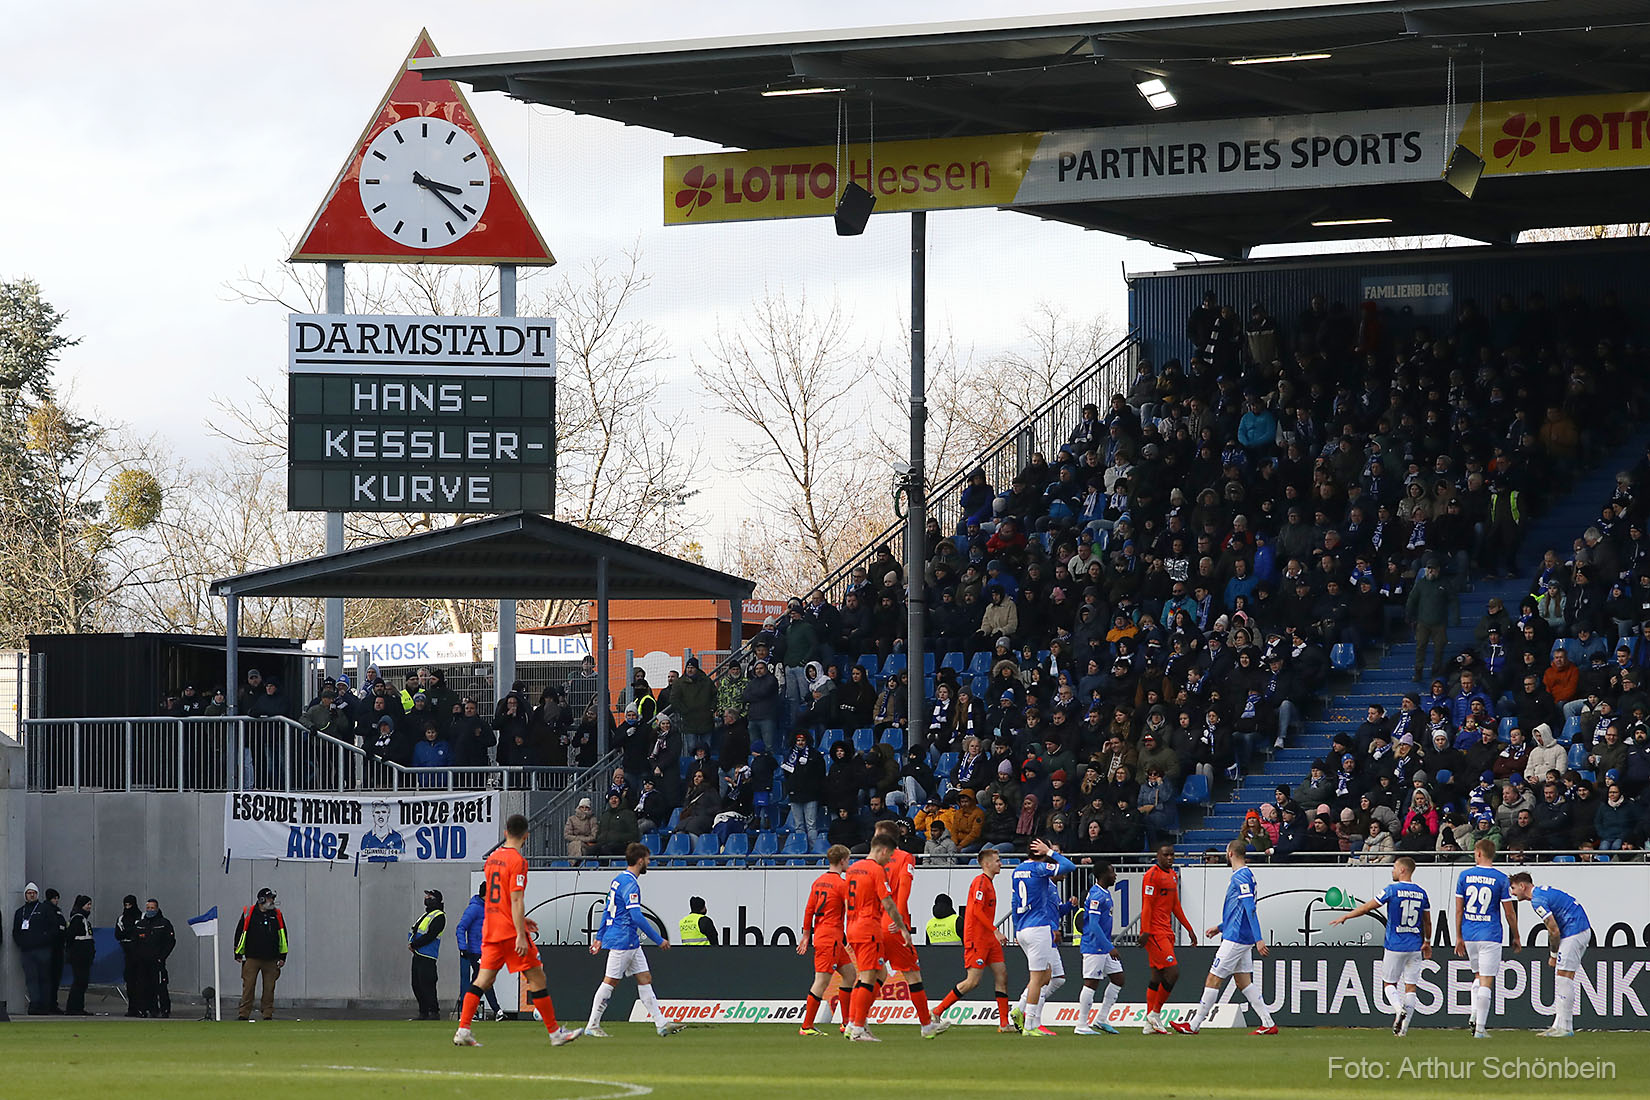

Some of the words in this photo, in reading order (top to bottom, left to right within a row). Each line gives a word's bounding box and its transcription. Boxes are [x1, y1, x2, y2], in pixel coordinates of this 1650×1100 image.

[1549, 109, 1650, 154] LOTT
[1057, 140, 1208, 182] PARTNER
[1218, 135, 1282, 174] DES
[1291, 130, 1423, 170] SPORTS
[723, 161, 838, 204] LOTTO
[849, 158, 991, 197] Hessen
[1364, 283, 1449, 299] FAMILIENBLOCK
[295, 322, 551, 357] DARMSTADT
[354, 383, 488, 412] HANS-
[325, 429, 544, 460] KESSLER-
[354, 475, 490, 503] KURVE
[742, 600, 763, 614] risch
[371, 642, 430, 662] KIOSK
[301, 799, 362, 825] HEINER
[286, 825, 350, 860] Allez
[415, 825, 467, 860] SVD
[490, 871, 501, 904] 6
[1018, 880, 1027, 908] 9
[1465, 885, 1492, 915] 29
[1400, 899, 1421, 927] 15
